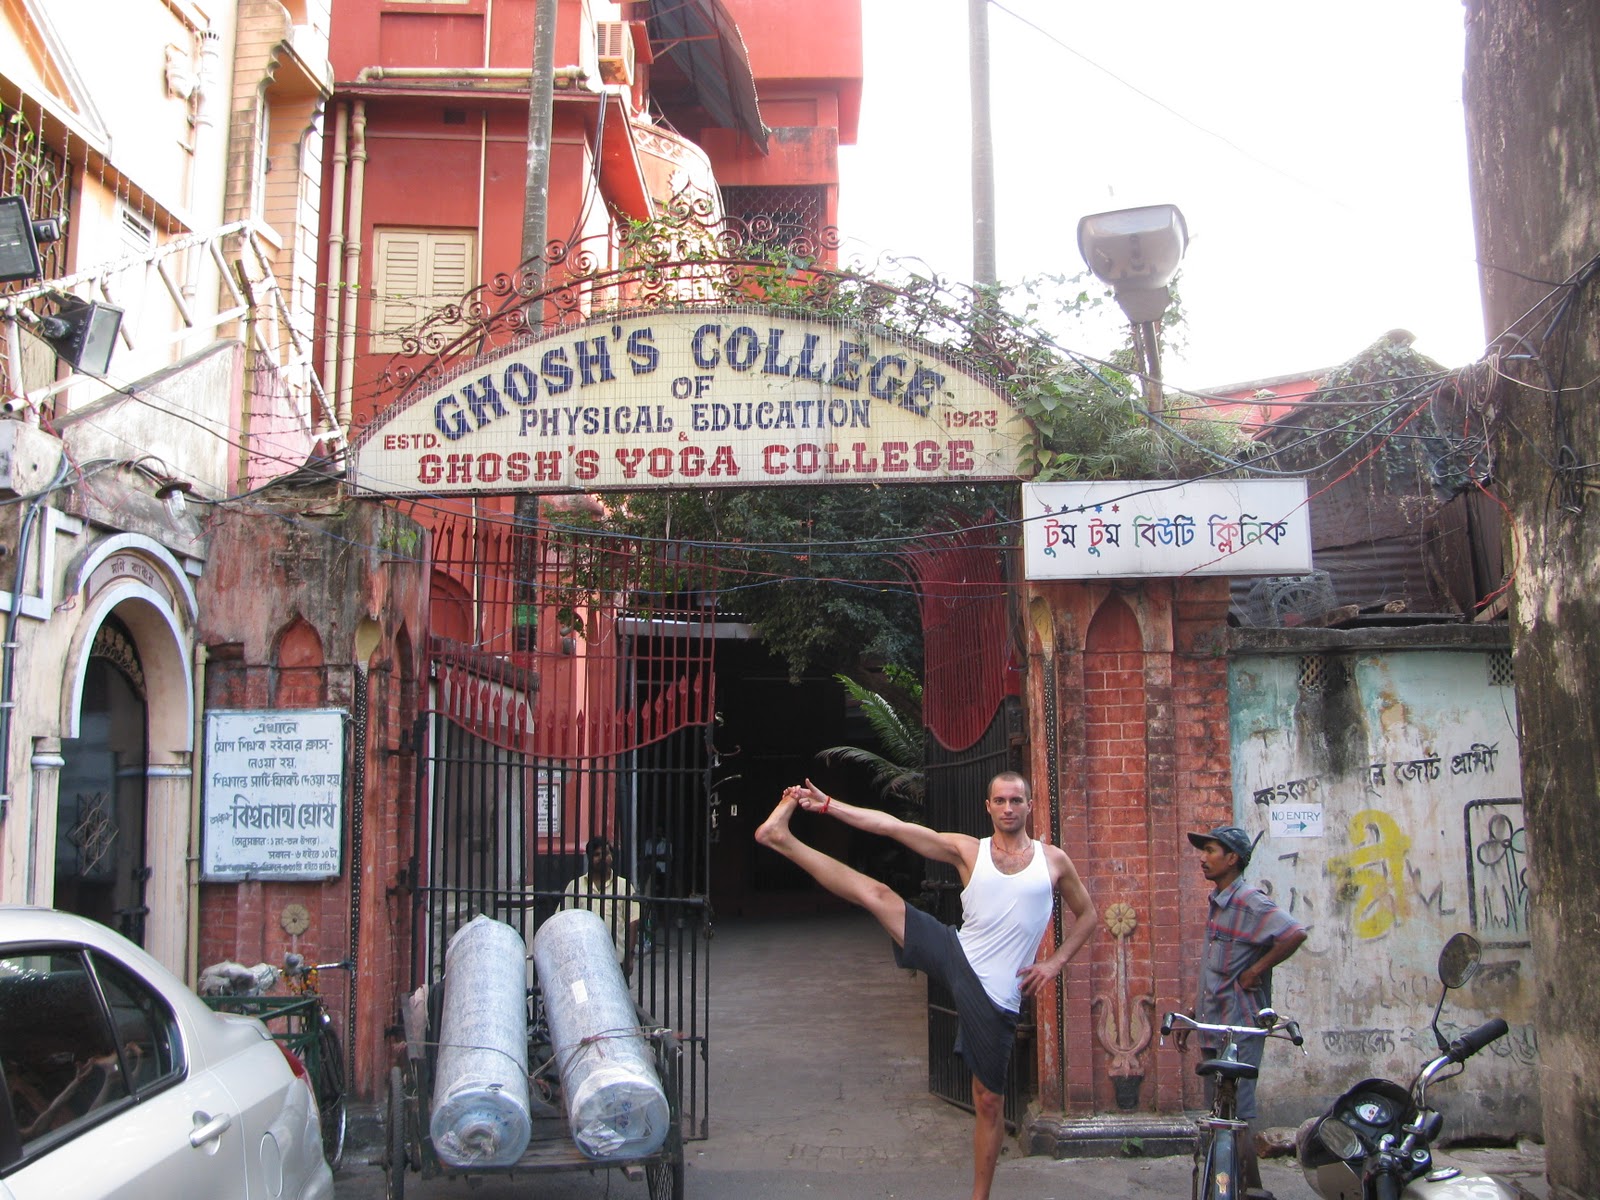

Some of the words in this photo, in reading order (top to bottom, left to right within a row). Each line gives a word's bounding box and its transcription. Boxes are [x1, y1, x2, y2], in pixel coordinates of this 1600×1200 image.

[433, 325, 660, 441] GHOSH'S
[690, 324, 945, 418] COLLEGE
[671, 375, 715, 400] OF
[384, 433, 441, 450] ESTD.
[944, 410, 998, 428] 1923
[519, 405, 674, 437] PHYSICAL
[690, 399, 870, 432] EDUCATION
[678, 431, 689, 442] &
[417, 445, 600, 484] GHOSH'S
[615, 445, 741, 479] YOGA
[761, 440, 975, 475] COLLEGE
[1044, 519, 1076, 558] টুম
[1088, 518, 1121, 558] টুম
[1132, 514, 1197, 548] বিউটি
[1208, 513, 1289, 553] ক্লিনিক
[253, 722, 298, 734] এখানে
[214, 741, 235, 753] যোগ
[238, 736, 266, 752] শিক্ষক
[270, 737, 303, 752] হইবার
[248, 757, 277, 769] নেওয়া
[1393, 752, 1442, 784] জোট
[230, 794, 296, 829] বিশ্বনাথ
[298, 803, 337, 829] ঘোষ
[1272, 811, 1285, 821] NO
[1286, 811, 1320, 822] ENTRY
